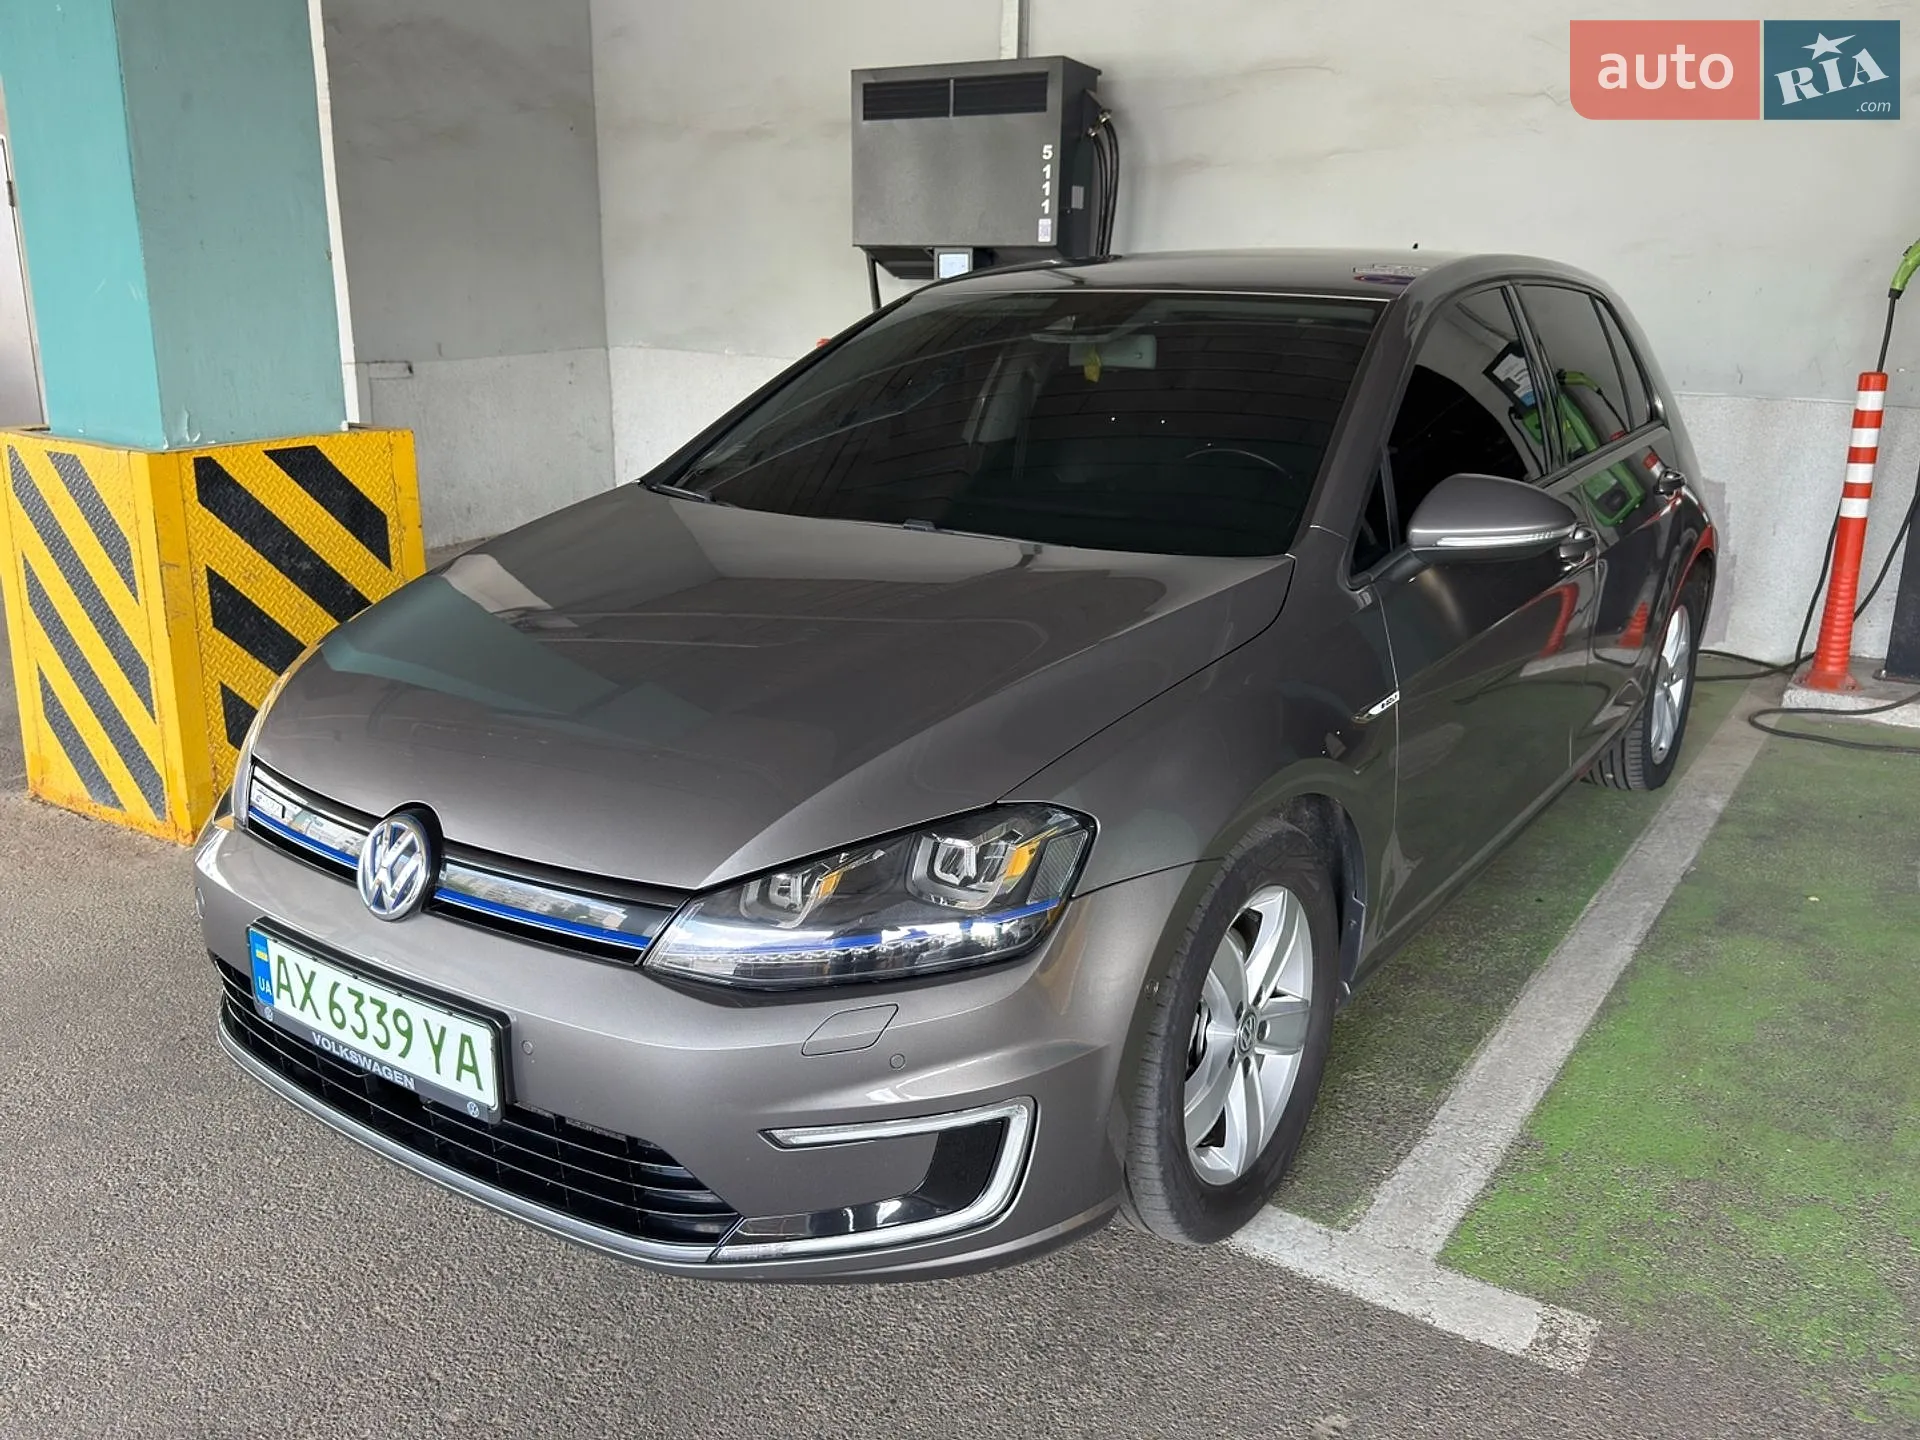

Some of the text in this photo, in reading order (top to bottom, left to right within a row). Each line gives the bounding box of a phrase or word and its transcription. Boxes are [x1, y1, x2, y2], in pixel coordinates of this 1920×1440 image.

[258, 976, 272, 996] UA
[275, 954, 484, 1091] AX 6339 YA
[311, 1031, 415, 1090] VOLKSWAGEN
